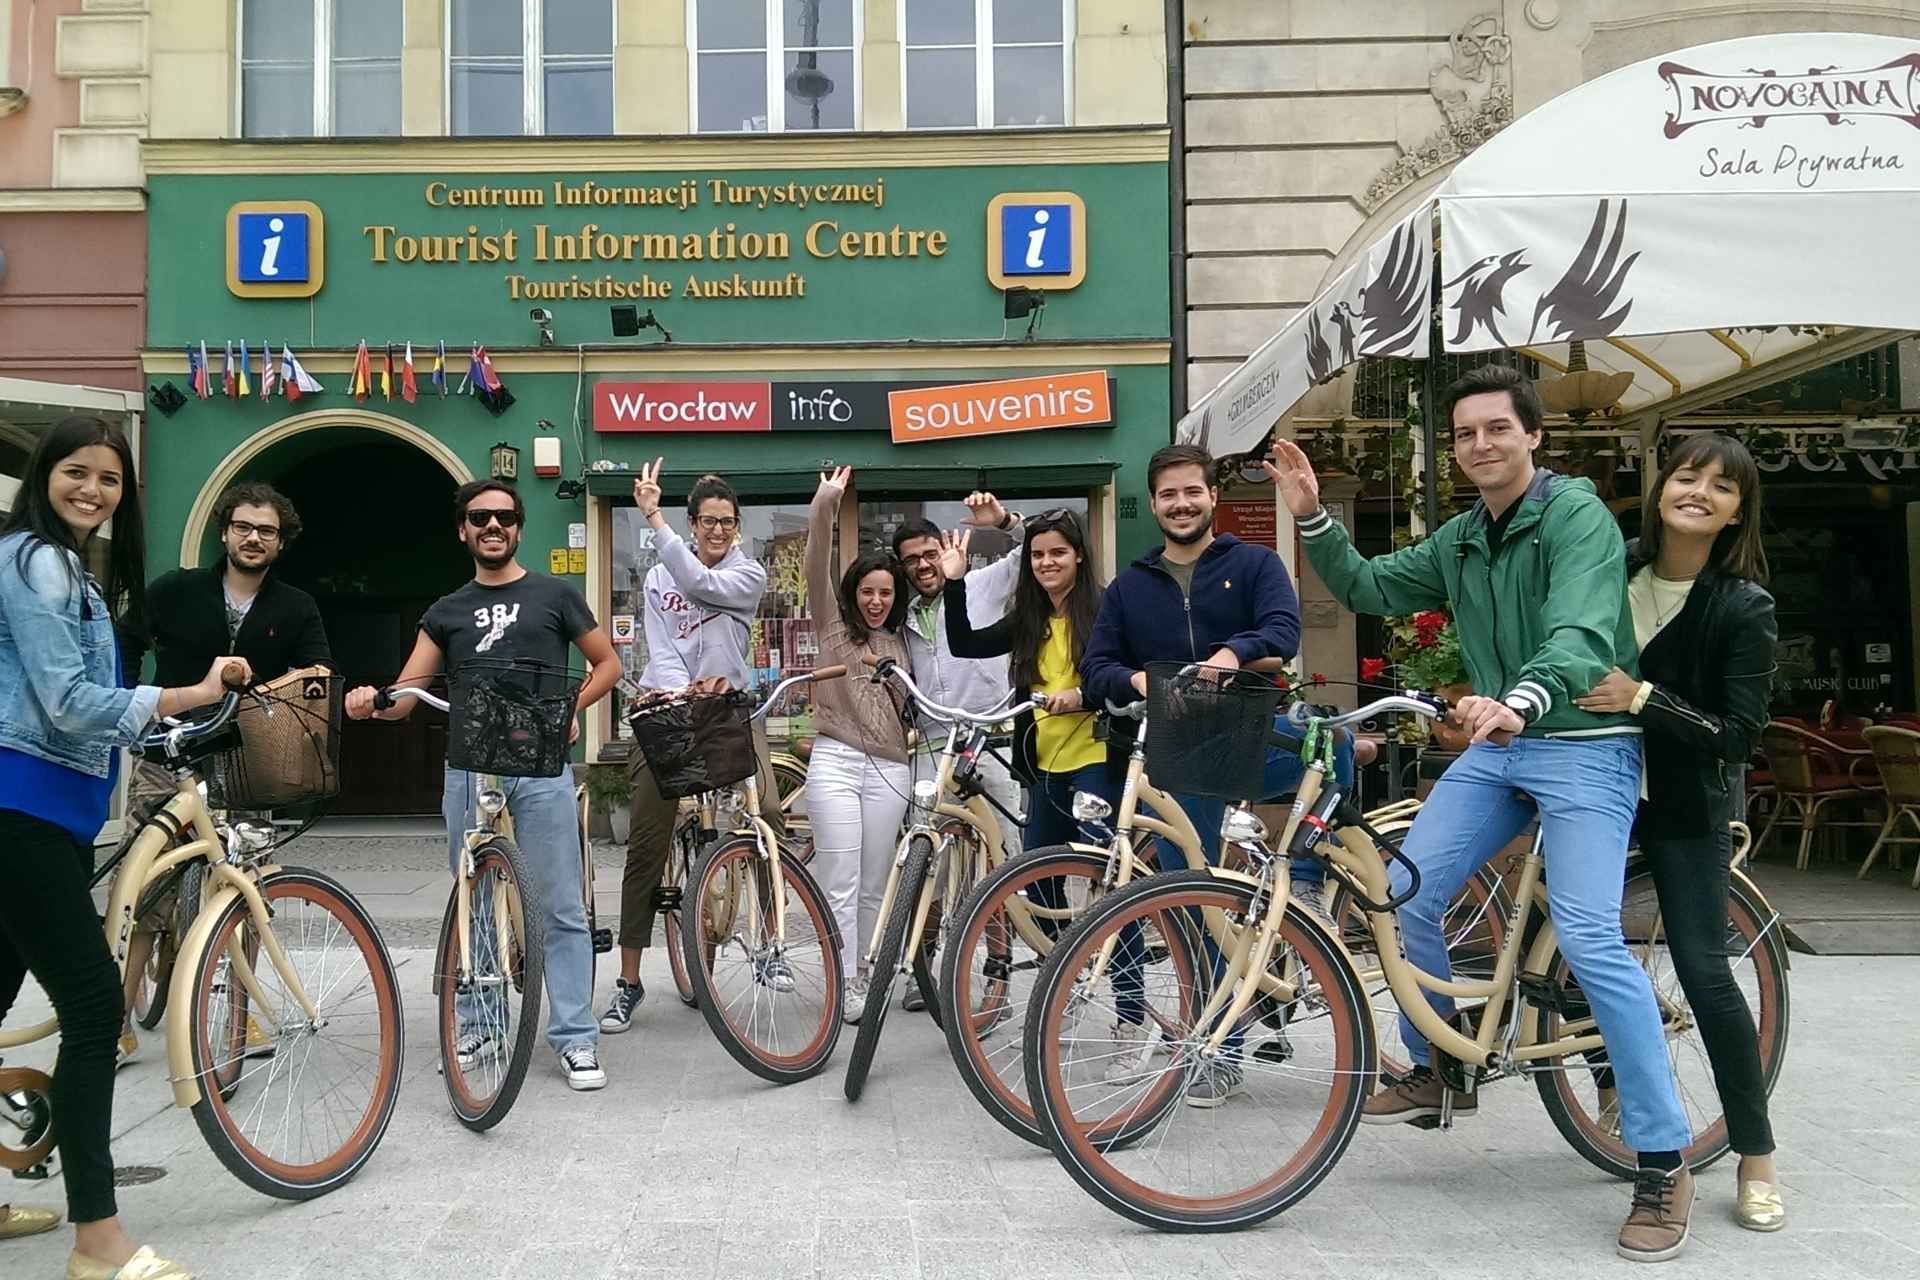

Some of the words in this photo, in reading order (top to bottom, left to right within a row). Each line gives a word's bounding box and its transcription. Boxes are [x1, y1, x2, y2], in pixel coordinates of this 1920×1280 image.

[1691, 79, 1903, 112] NOVOCAINA
[1699, 147, 1763, 178] Sala
[1773, 144, 1904, 189] Prywatna
[425, 181, 544, 206] Centrum
[553, 179, 697, 210] Informacji
[707, 177, 885, 208] Turystycznej
[362, 224, 519, 262] Tourist
[532, 222, 790, 261] Information
[805, 220, 948, 258] Centre
[504, 274, 673, 300] Touristische
[682, 272, 807, 298] Auskunft
[608, 390, 758, 423] Wrocław
[788, 388, 853, 423] info
[904, 383, 1095, 431] souvenirs
[1803, 678, 1842, 691] MUSIC
